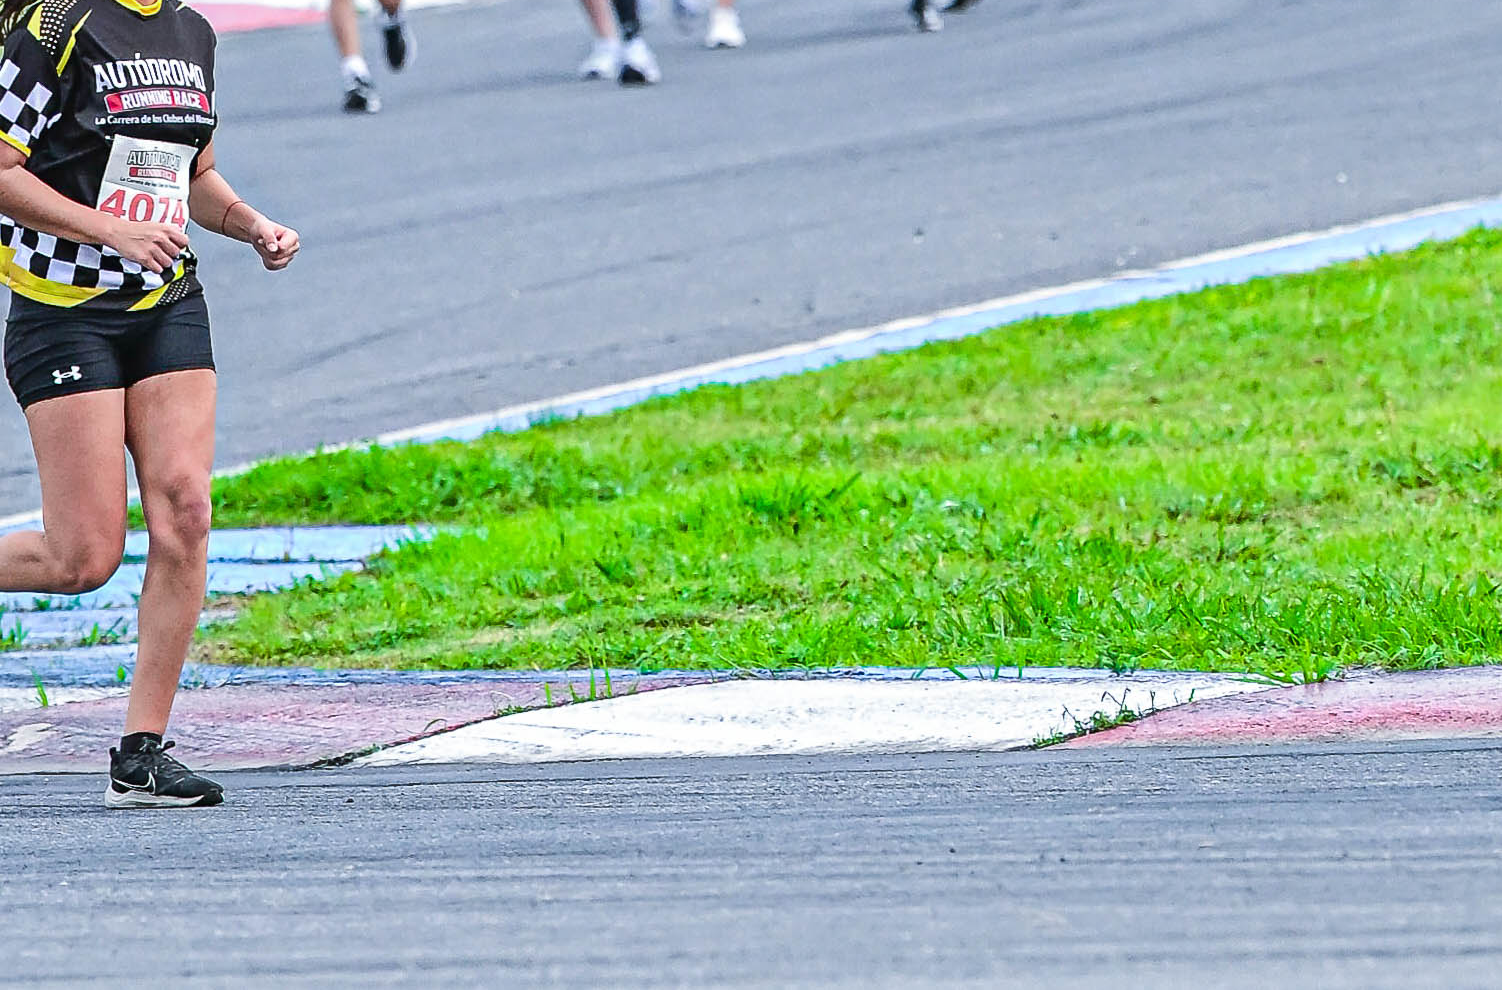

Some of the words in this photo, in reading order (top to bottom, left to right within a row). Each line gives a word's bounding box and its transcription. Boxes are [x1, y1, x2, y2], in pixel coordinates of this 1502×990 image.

[93, 52, 206, 93] AUTÓDROMO
[120, 89, 172, 110] RUNNING
[172, 90, 203, 109] RACE
[95, 117, 106, 125] La
[107, 115, 140, 125] Carrera
[141, 114, 152, 124] de
[152, 114, 162, 123] los
[184, 114, 195, 123] del
[100, 189, 185, 228] 4074
